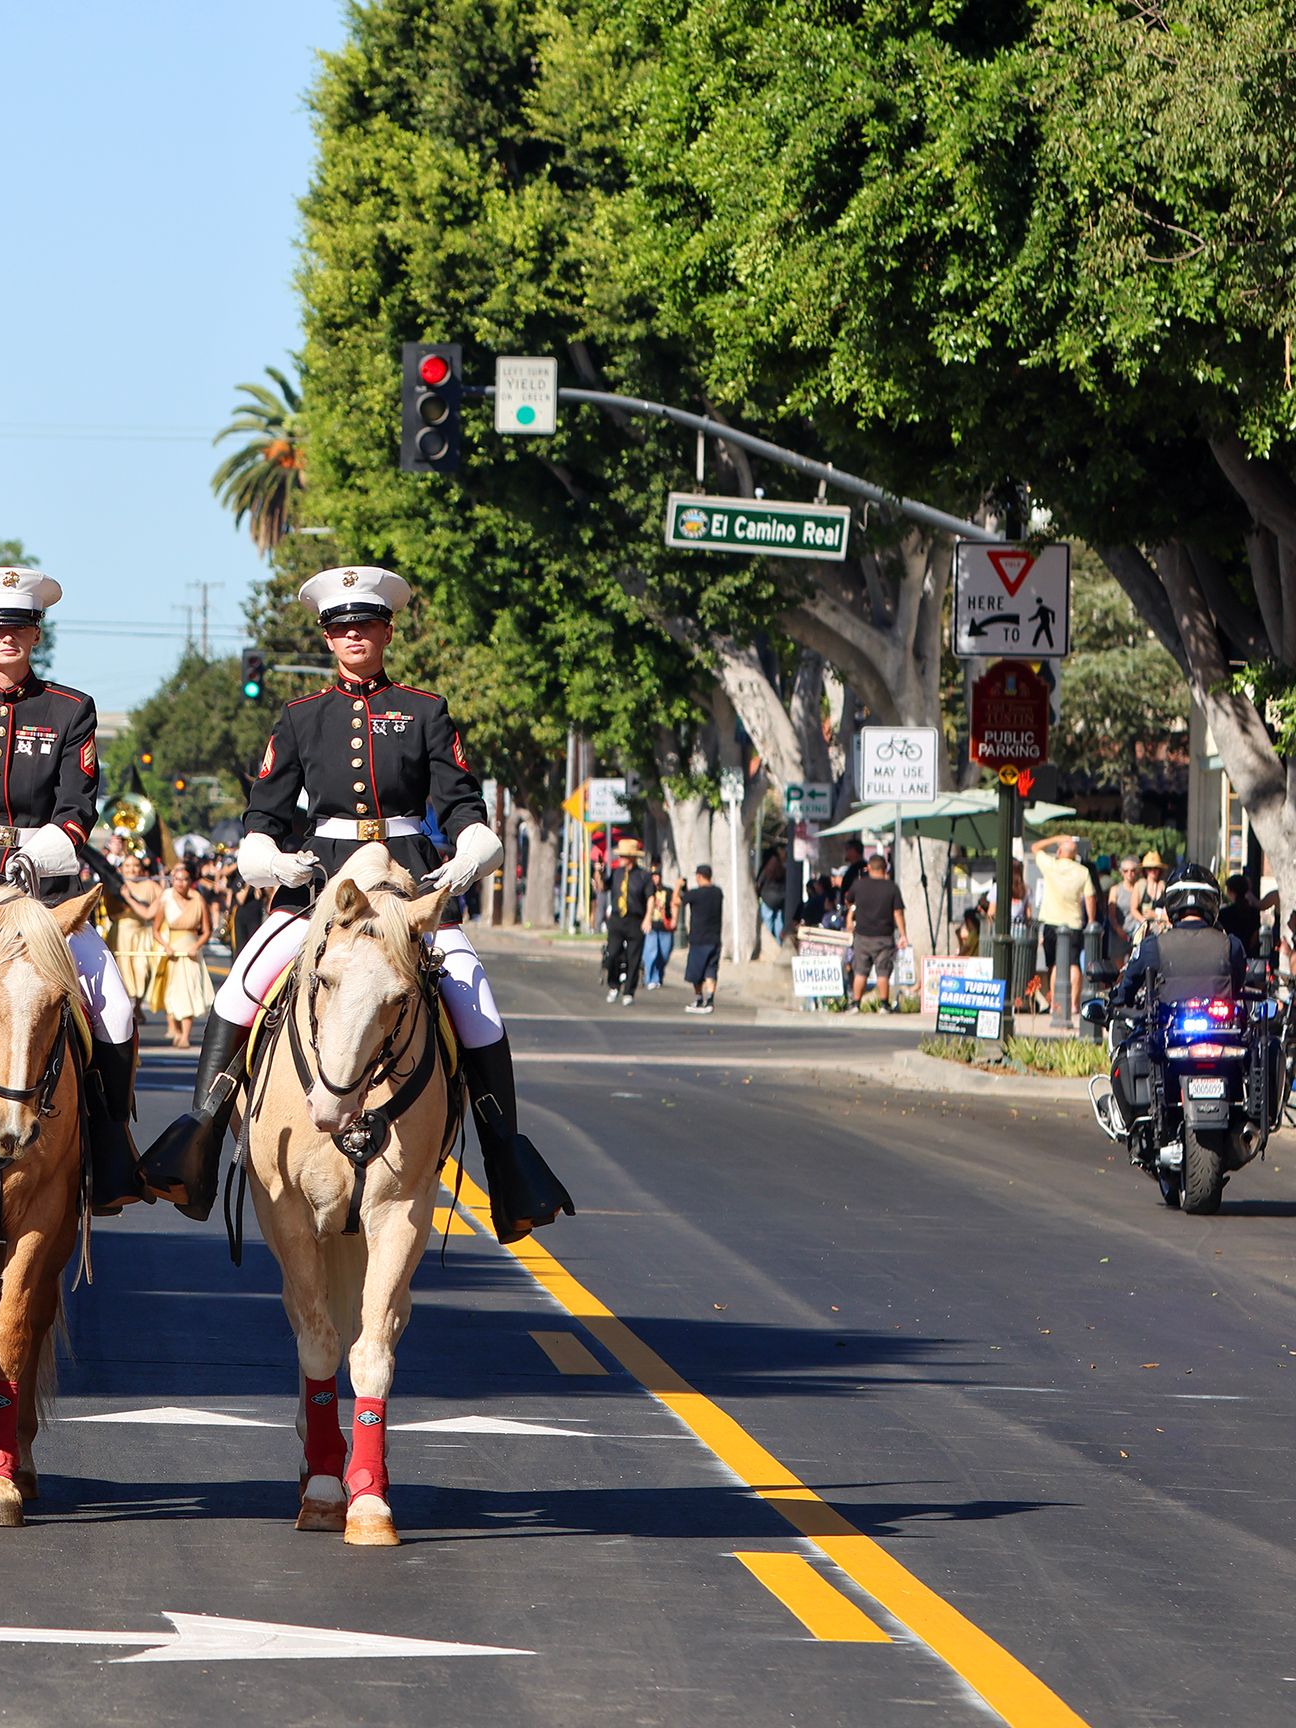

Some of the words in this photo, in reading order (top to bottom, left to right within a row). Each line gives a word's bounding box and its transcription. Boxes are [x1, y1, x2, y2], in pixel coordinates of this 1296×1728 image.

[506, 378, 546, 390] YIELD
[710, 513, 728, 538] El
[733, 514, 797, 544] Camino
[802, 520, 841, 547] Real
[967, 595, 1005, 611] HERE
[1003, 626, 1021, 643] TO
[984, 712, 1035, 725] TUSTIN
[984, 730, 1035, 745] PUBLIC
[977, 742, 1041, 759] PARKING
[873, 766, 896, 777] MAY
[903, 766, 924, 777] USE
[867, 782, 894, 795] FULL
[900, 782, 931, 795] LANE
[794, 967, 841, 984] LUMBARD
[964, 980, 1001, 996] TUSTIN
[940, 991, 1001, 1009] BASKETBALL
